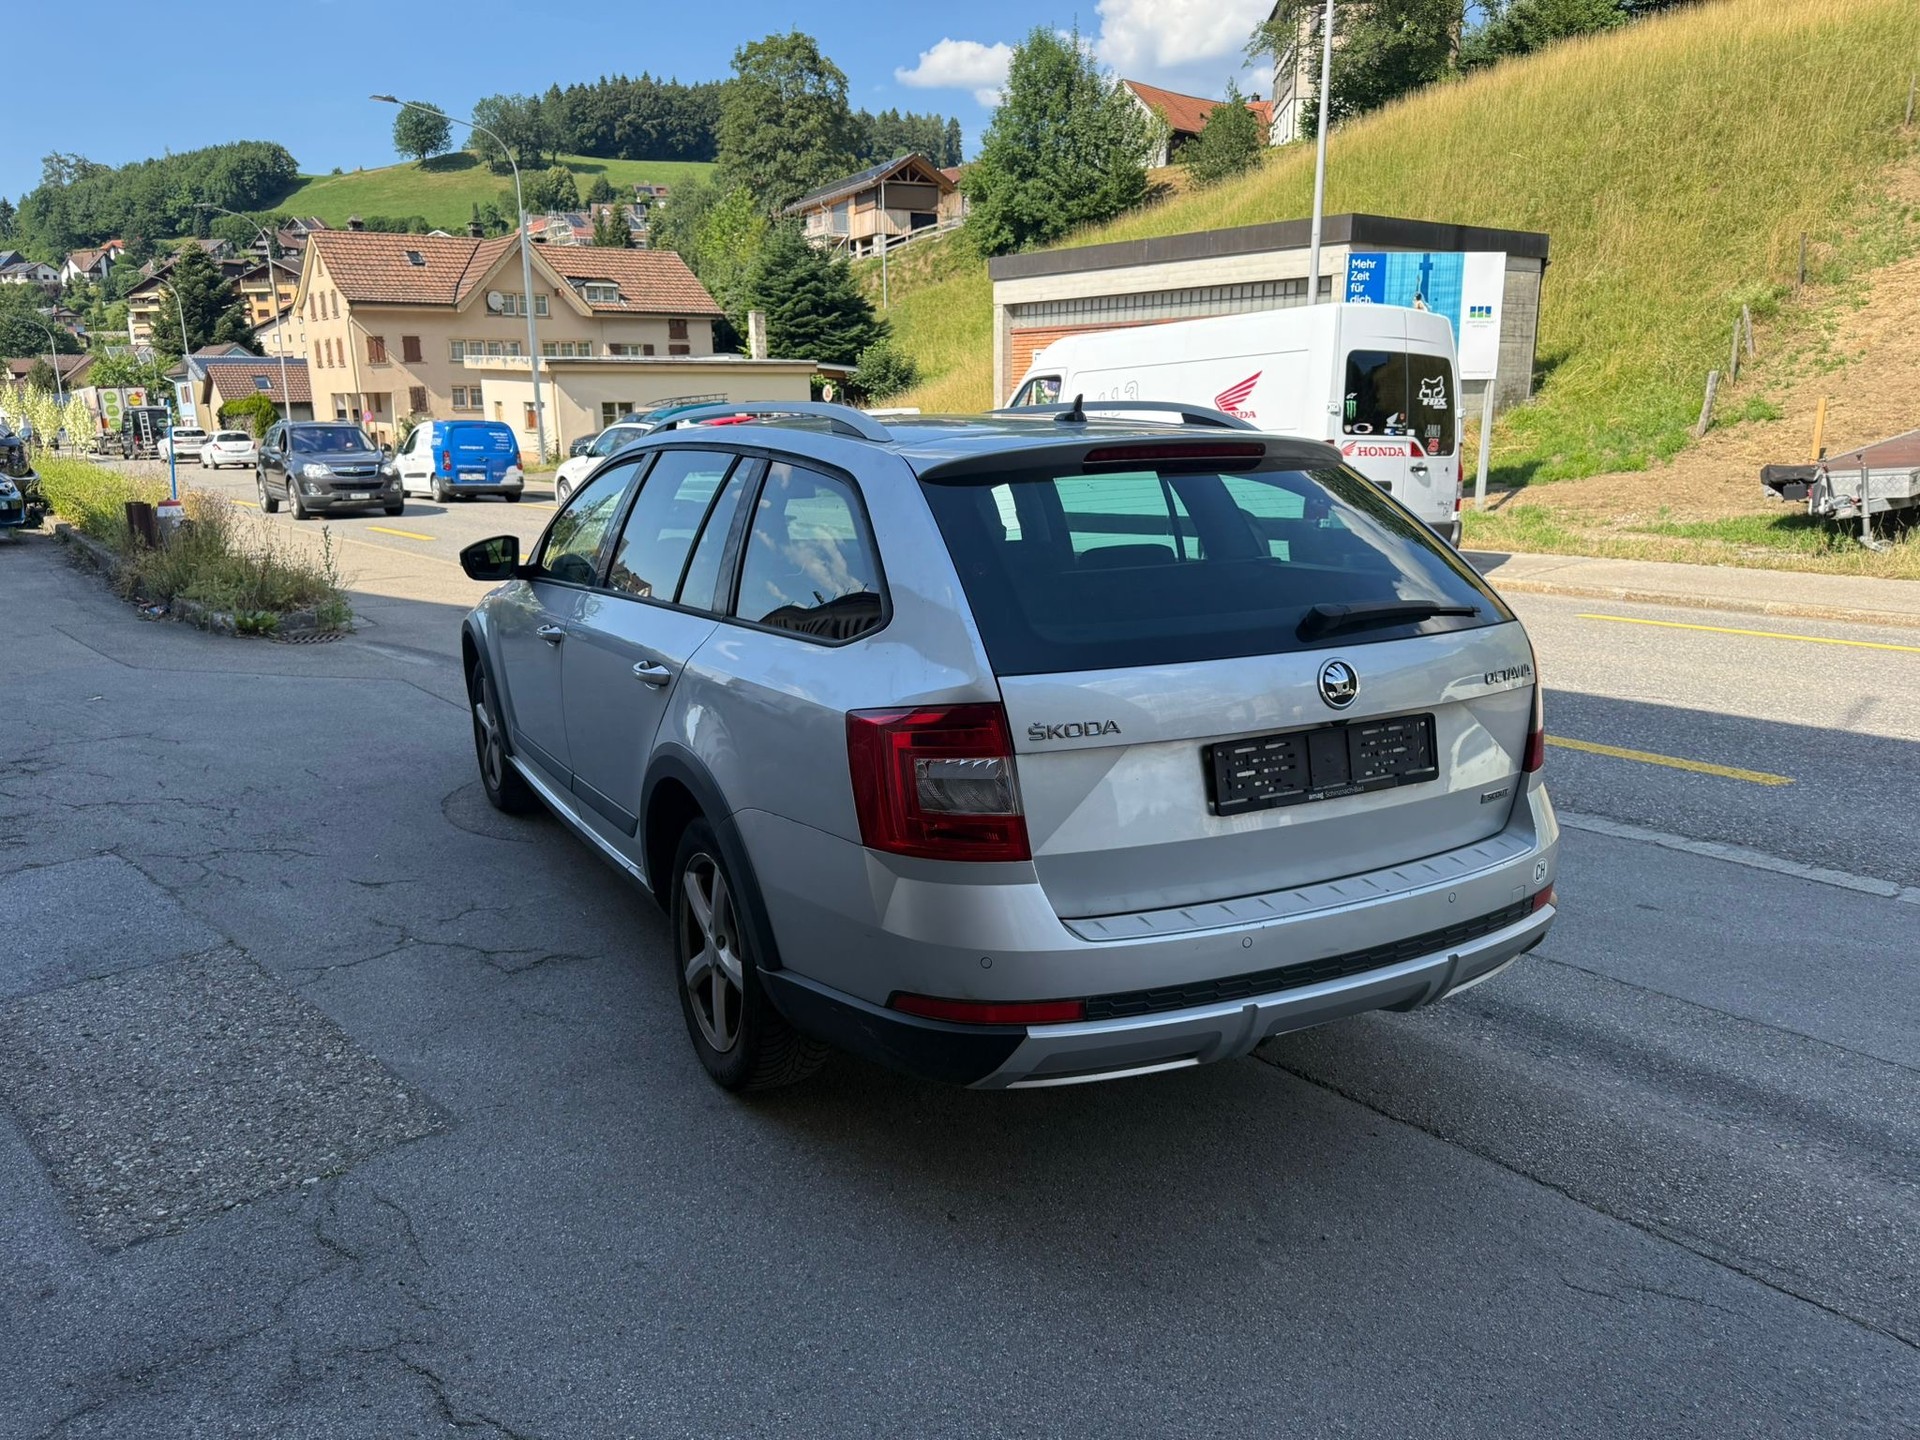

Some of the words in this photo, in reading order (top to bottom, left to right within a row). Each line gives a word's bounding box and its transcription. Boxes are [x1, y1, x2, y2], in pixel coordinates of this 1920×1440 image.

[1351, 258, 1376, 269] Mehr
[1350, 271, 1370, 281] Zeit
[1350, 282, 1365, 293] für
[1349, 295, 1374, 304] dich.
[1231, 410, 1257, 419] NDA
[1357, 446, 1406, 457] HONDA
[1027, 719, 1122, 741] ŠKODA
[1487, 788, 1509, 801] SCOUT
[1535, 862, 1546, 881] CH
